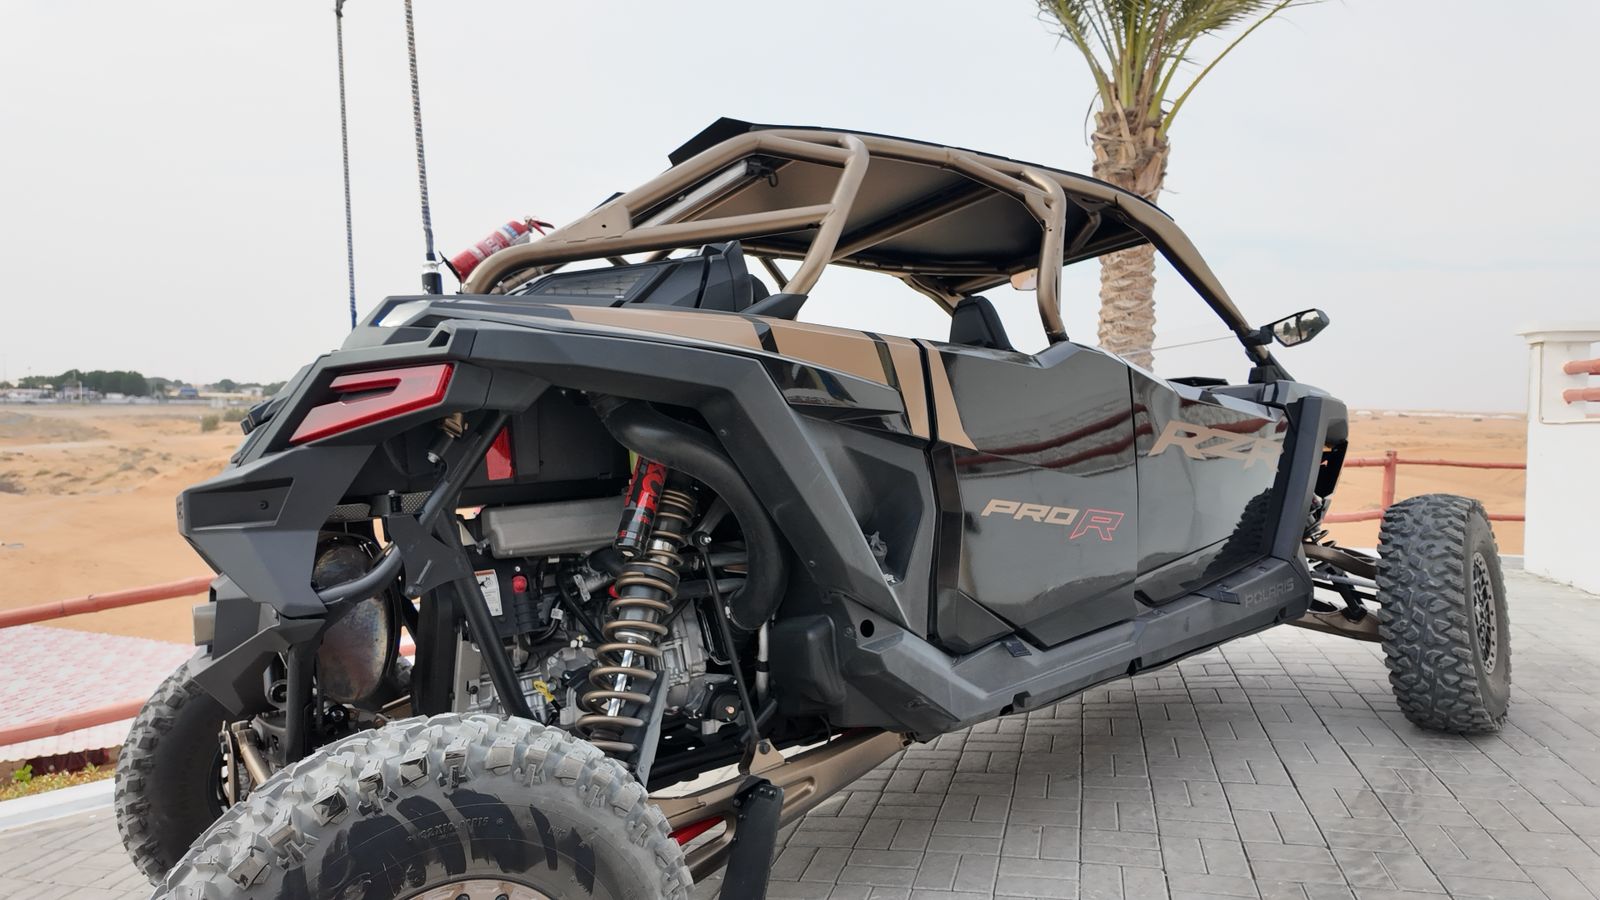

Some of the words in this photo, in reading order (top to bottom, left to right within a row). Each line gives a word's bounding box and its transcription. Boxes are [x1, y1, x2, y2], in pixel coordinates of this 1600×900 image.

[1148, 420, 1284, 473] RZR
[981, 499, 1079, 526] PRO
[1069, 508, 1125, 541] R
[1244, 577, 1295, 609] POLARIS
